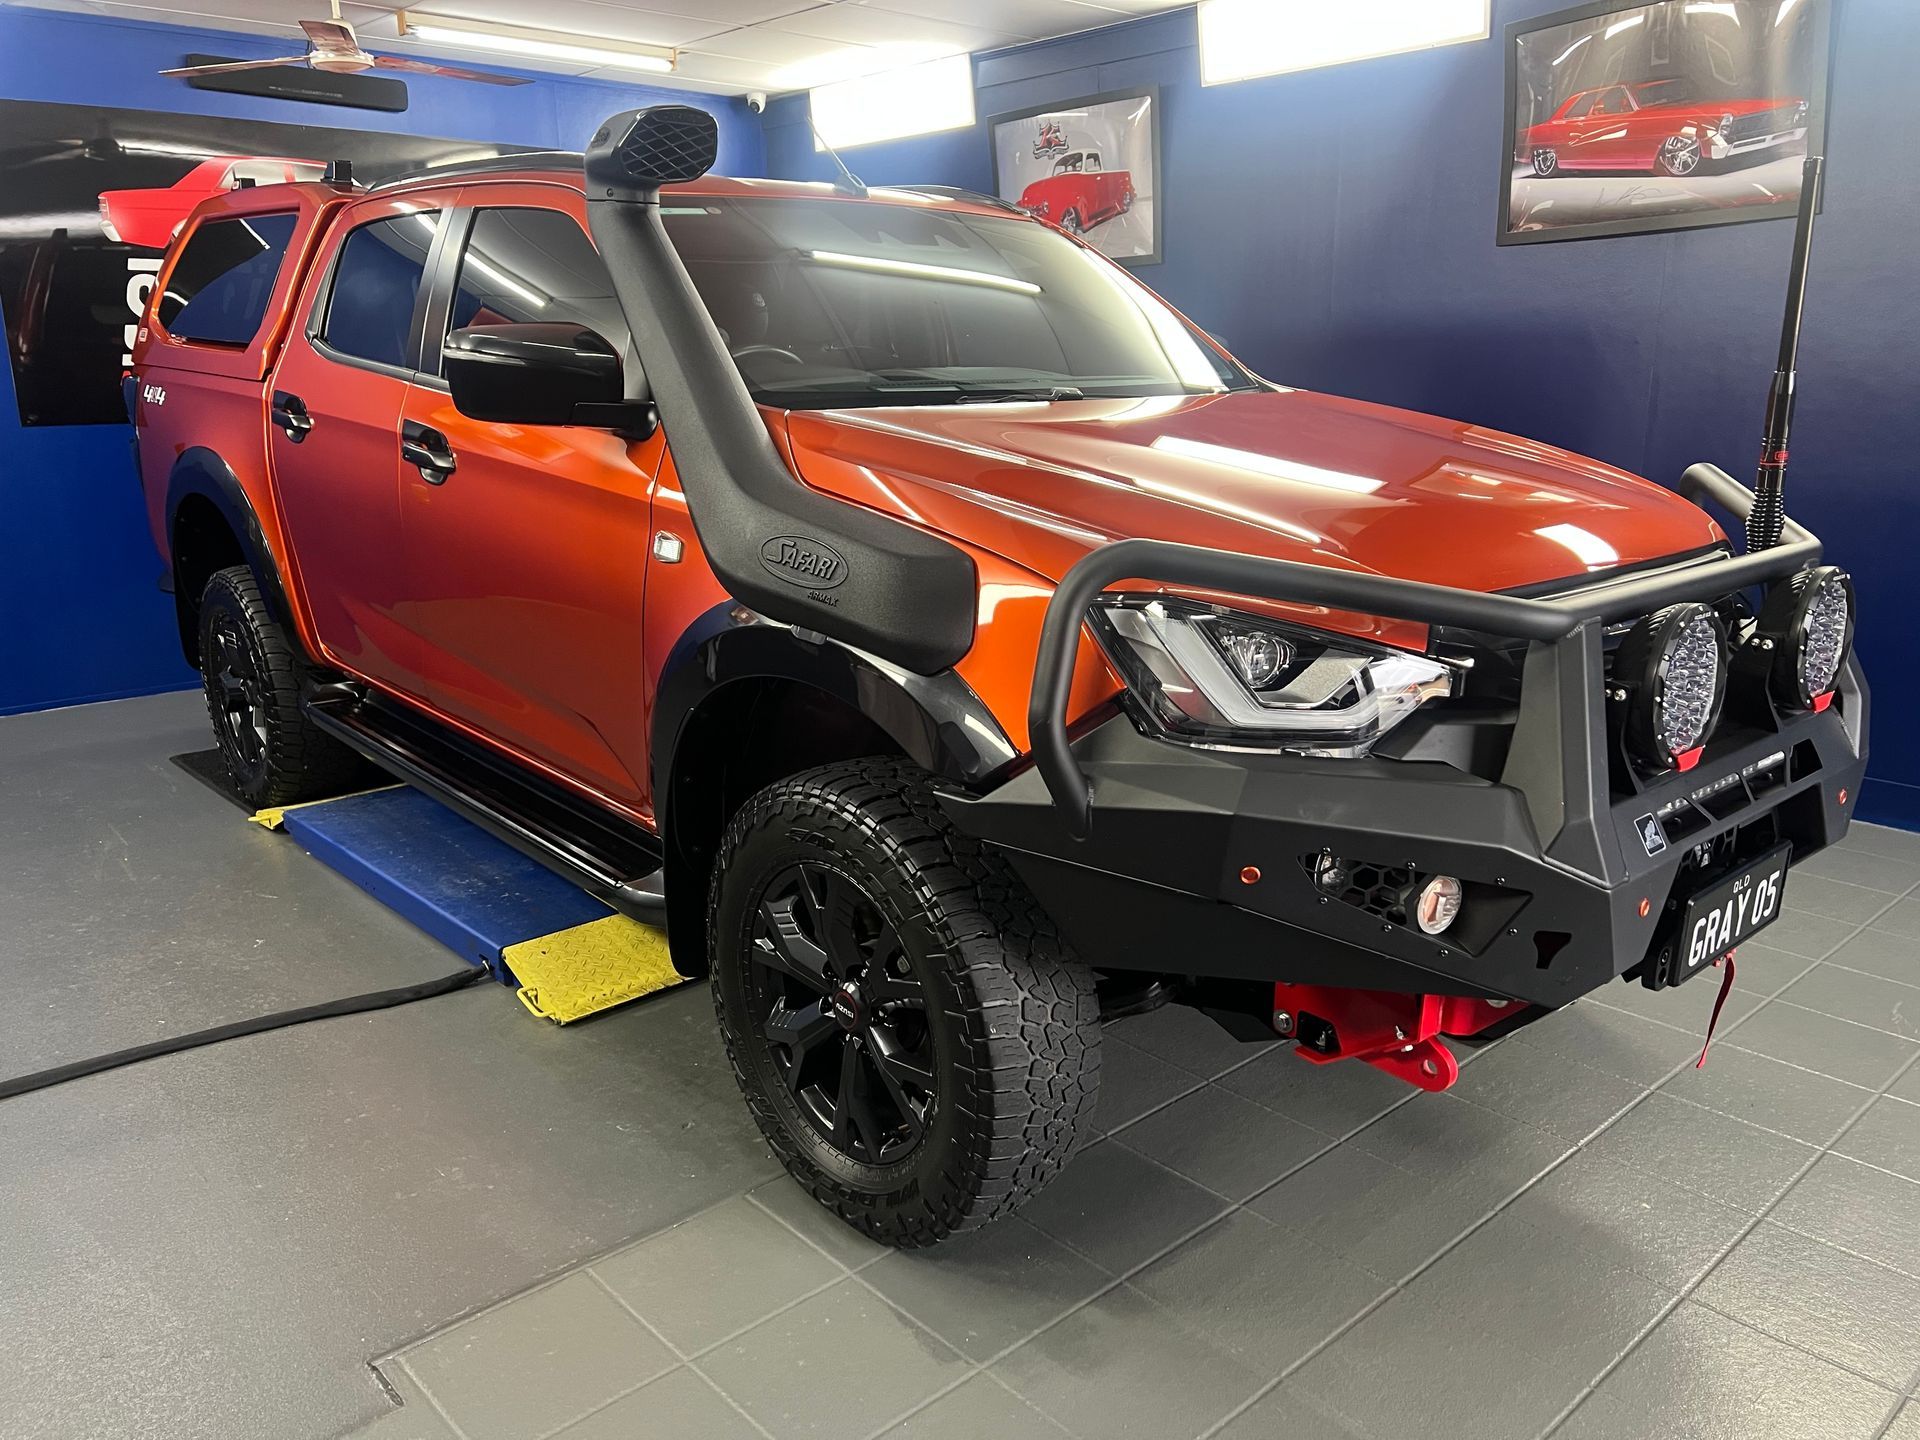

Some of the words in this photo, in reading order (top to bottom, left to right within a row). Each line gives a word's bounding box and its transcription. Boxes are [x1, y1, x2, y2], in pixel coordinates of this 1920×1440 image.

[766, 540, 839, 580] SAFARI
[808, 591, 839, 607] ARMAX
[1733, 874, 1751, 893] QLD
[1688, 888, 1752, 967] GRAY
[1751, 870, 1780, 925] 05
[836, 1003, 854, 1018] ISUZU
